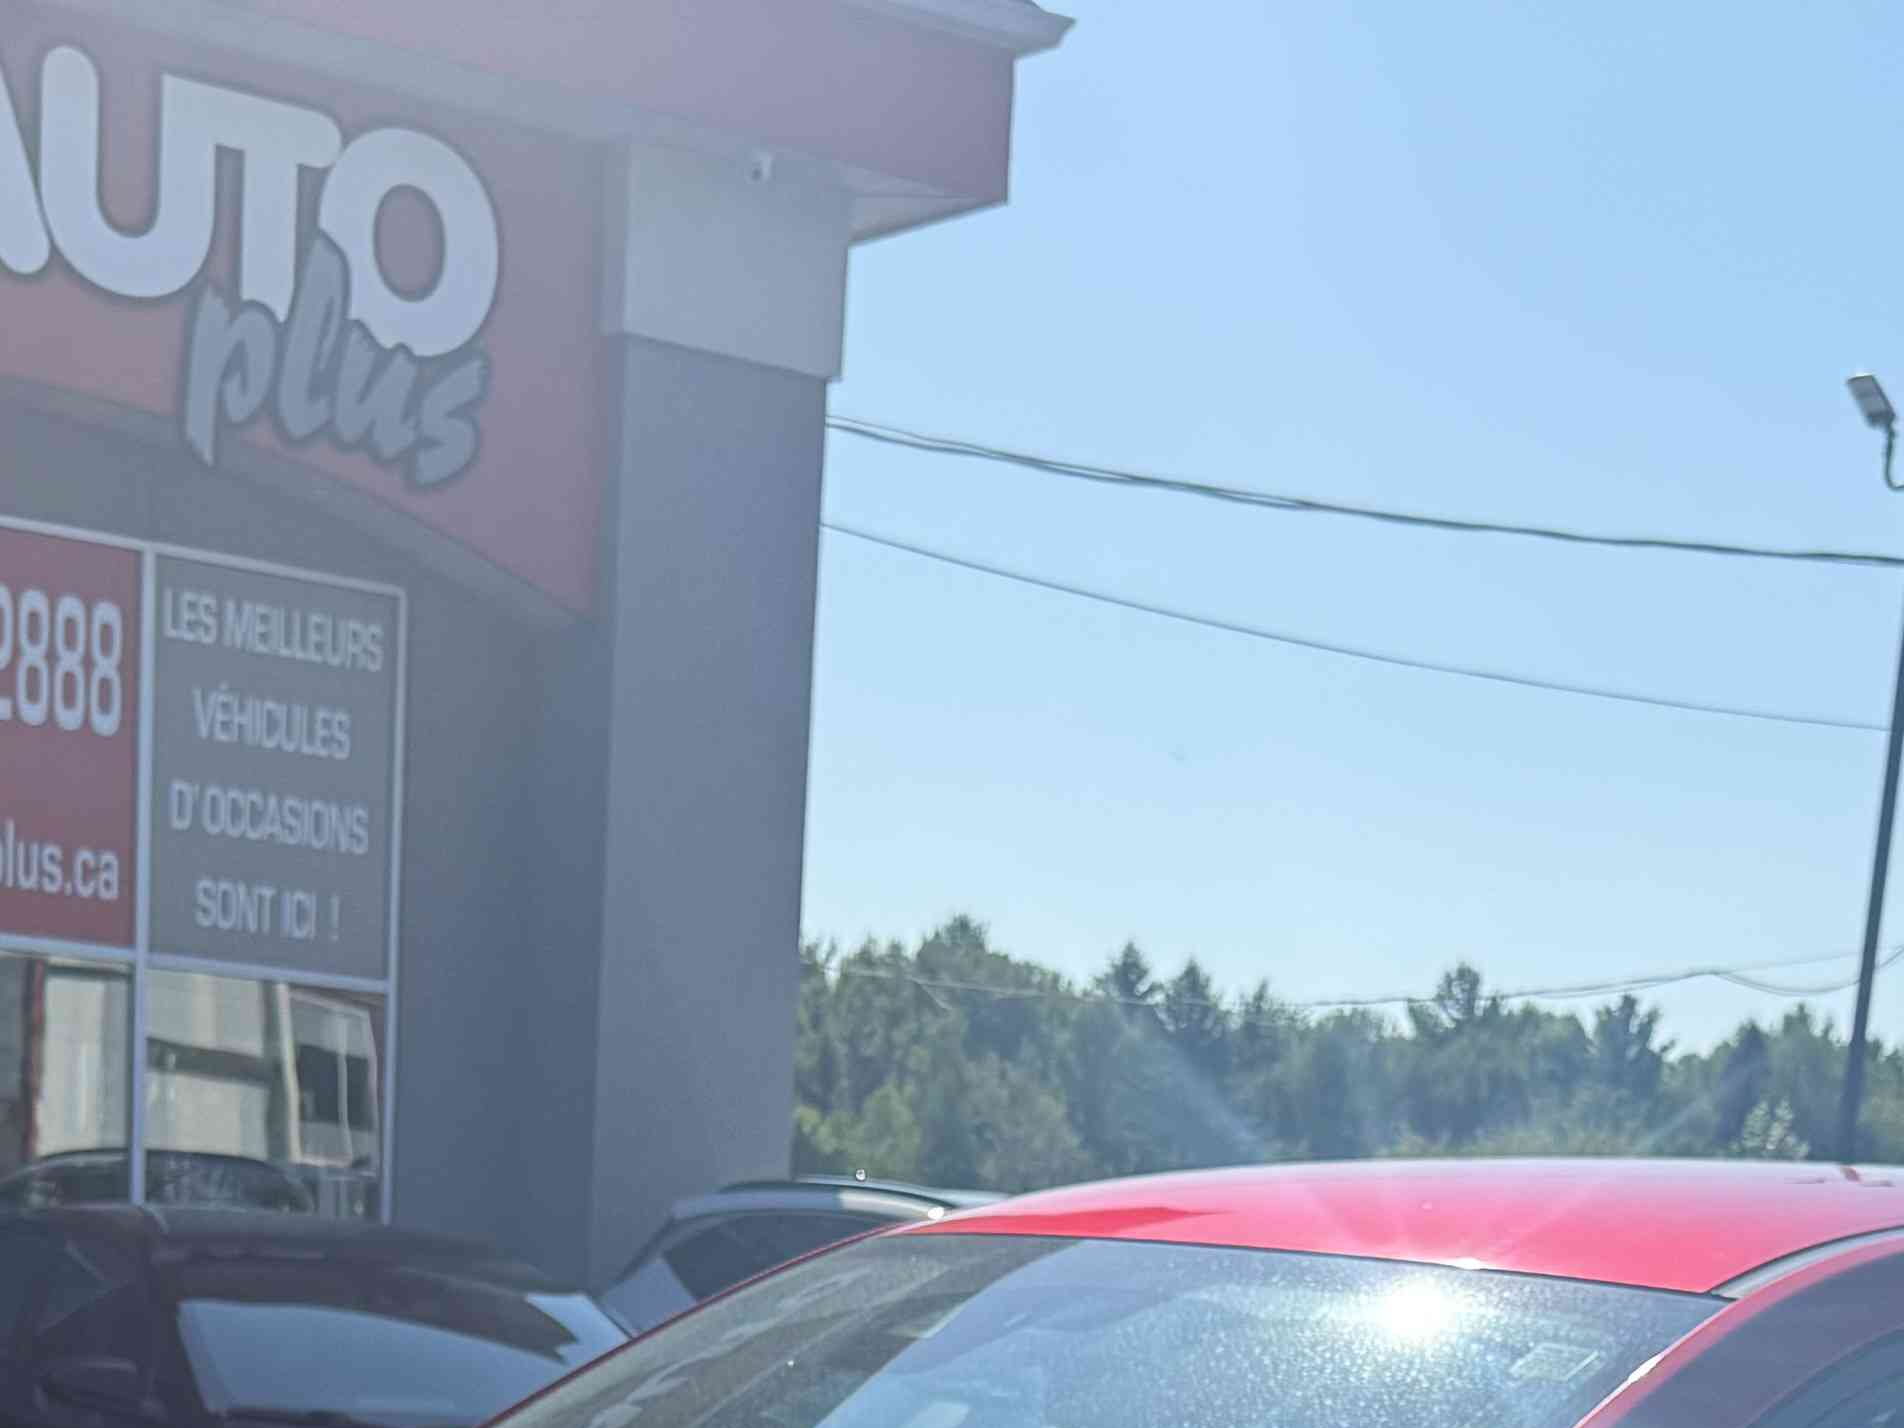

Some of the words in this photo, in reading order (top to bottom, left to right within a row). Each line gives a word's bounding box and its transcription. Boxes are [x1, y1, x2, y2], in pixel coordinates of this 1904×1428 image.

[184, 235, 494, 488] plus
[163, 587, 217, 645] LES
[222, 599, 385, 673] MEILLEURS
[193, 682, 352, 760] VÉHICULES
[195, 876, 277, 935] SONT
[279, 890, 318, 941] ICI
